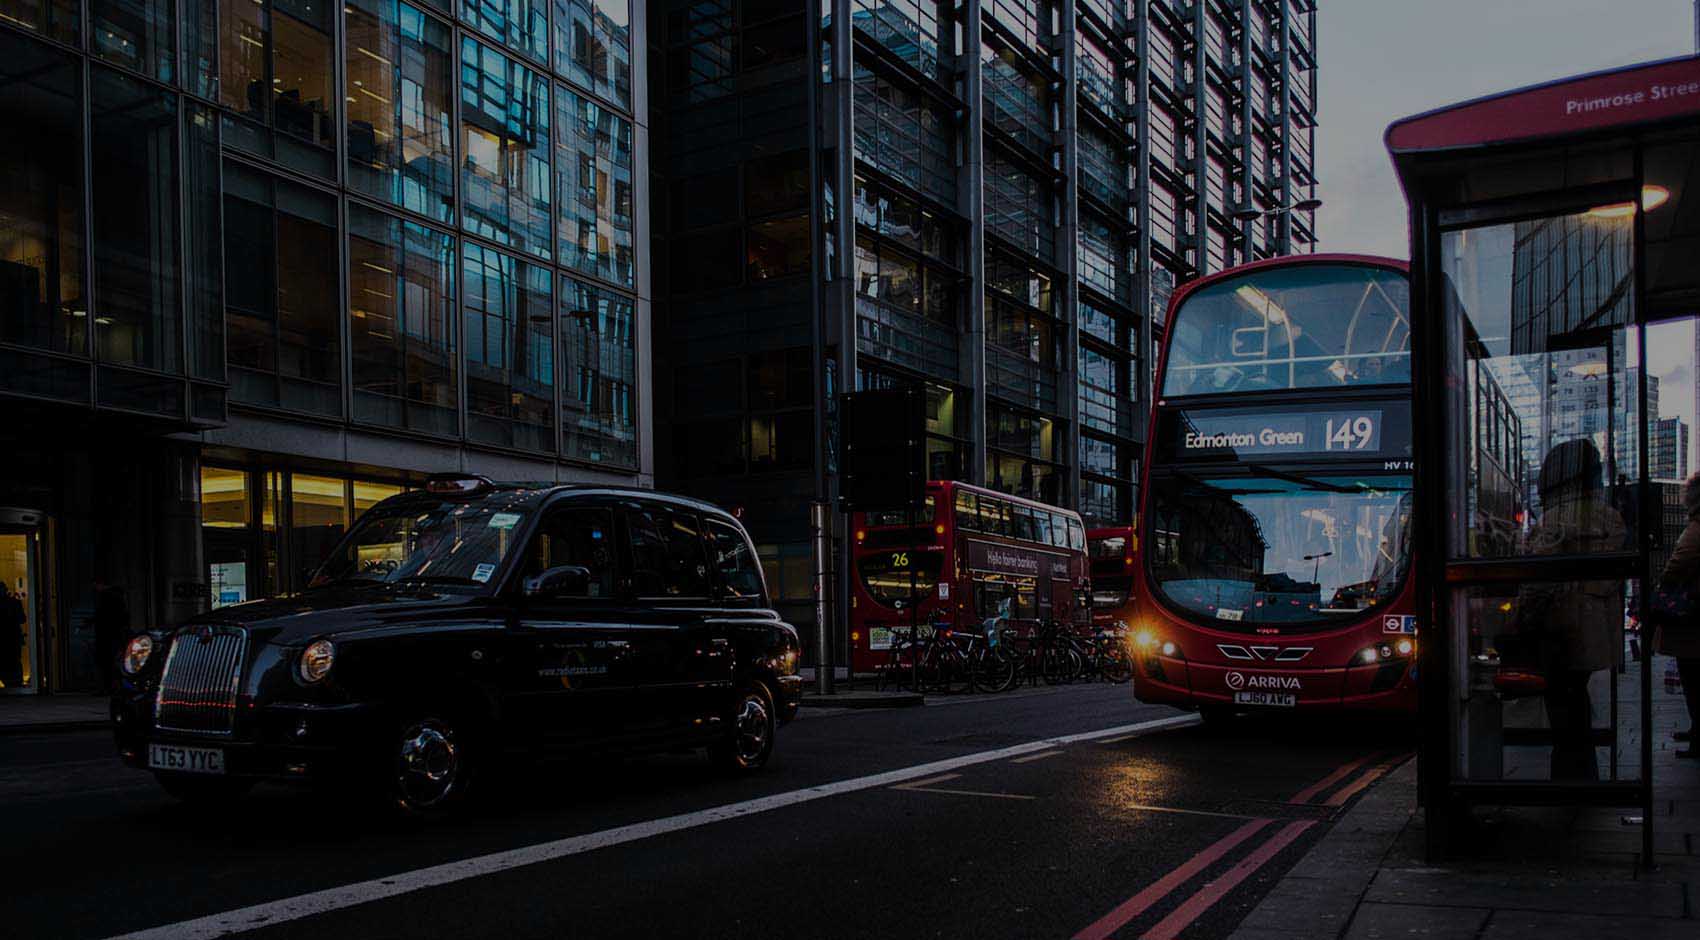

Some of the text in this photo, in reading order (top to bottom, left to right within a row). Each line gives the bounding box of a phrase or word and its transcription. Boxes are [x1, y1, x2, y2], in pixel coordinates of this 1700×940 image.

[1566, 82, 1699, 116] Primrose Stree
[1185, 428, 1304, 449] Edmonton Green
[1325, 416, 1373, 451] 149
[1384, 461, 1401, 470] HV
[891, 552, 910, 568] 26
[987, 550, 1002, 566] Hello
[1248, 675, 1301, 689] ARRIVA
[1240, 692, 1291, 706] LJ60 AWG
[152, 746, 219, 770] LT63 YYC
